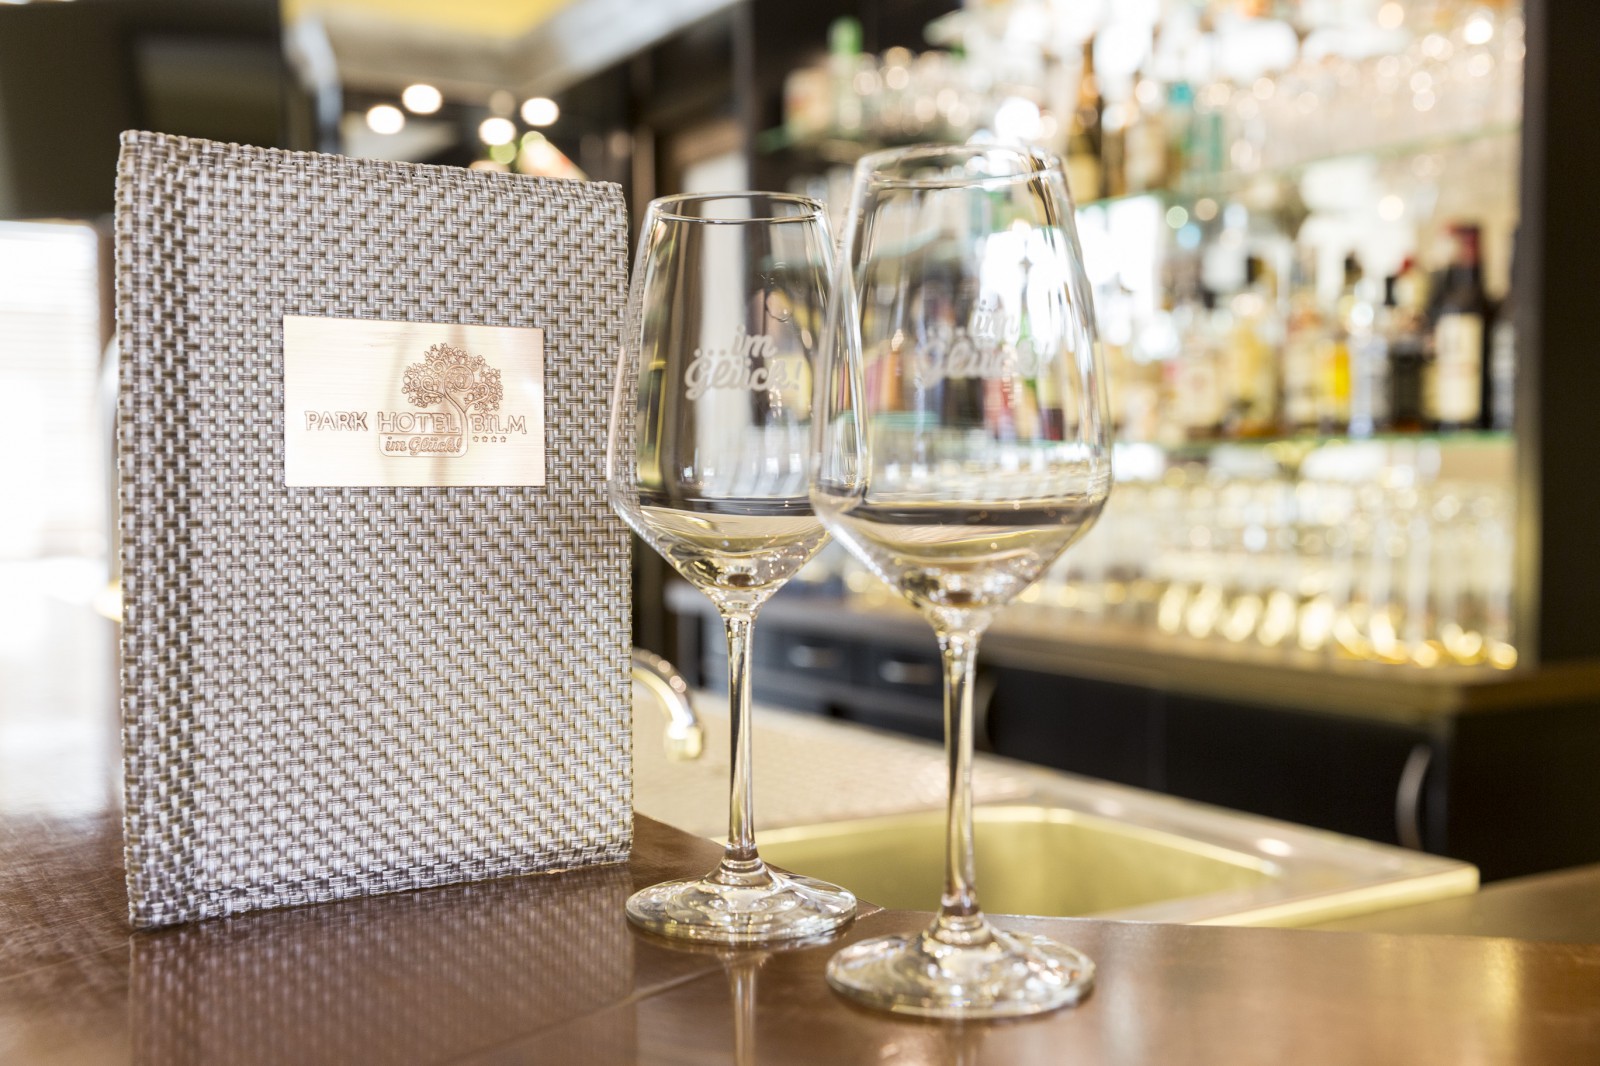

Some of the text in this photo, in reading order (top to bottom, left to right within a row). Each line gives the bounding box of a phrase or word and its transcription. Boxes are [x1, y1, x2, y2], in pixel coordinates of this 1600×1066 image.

[684, 358, 803, 400] Glück!
[304, 410, 527, 435] PARK HOTEL BILM
[385, 436, 463, 456] im Glück!
